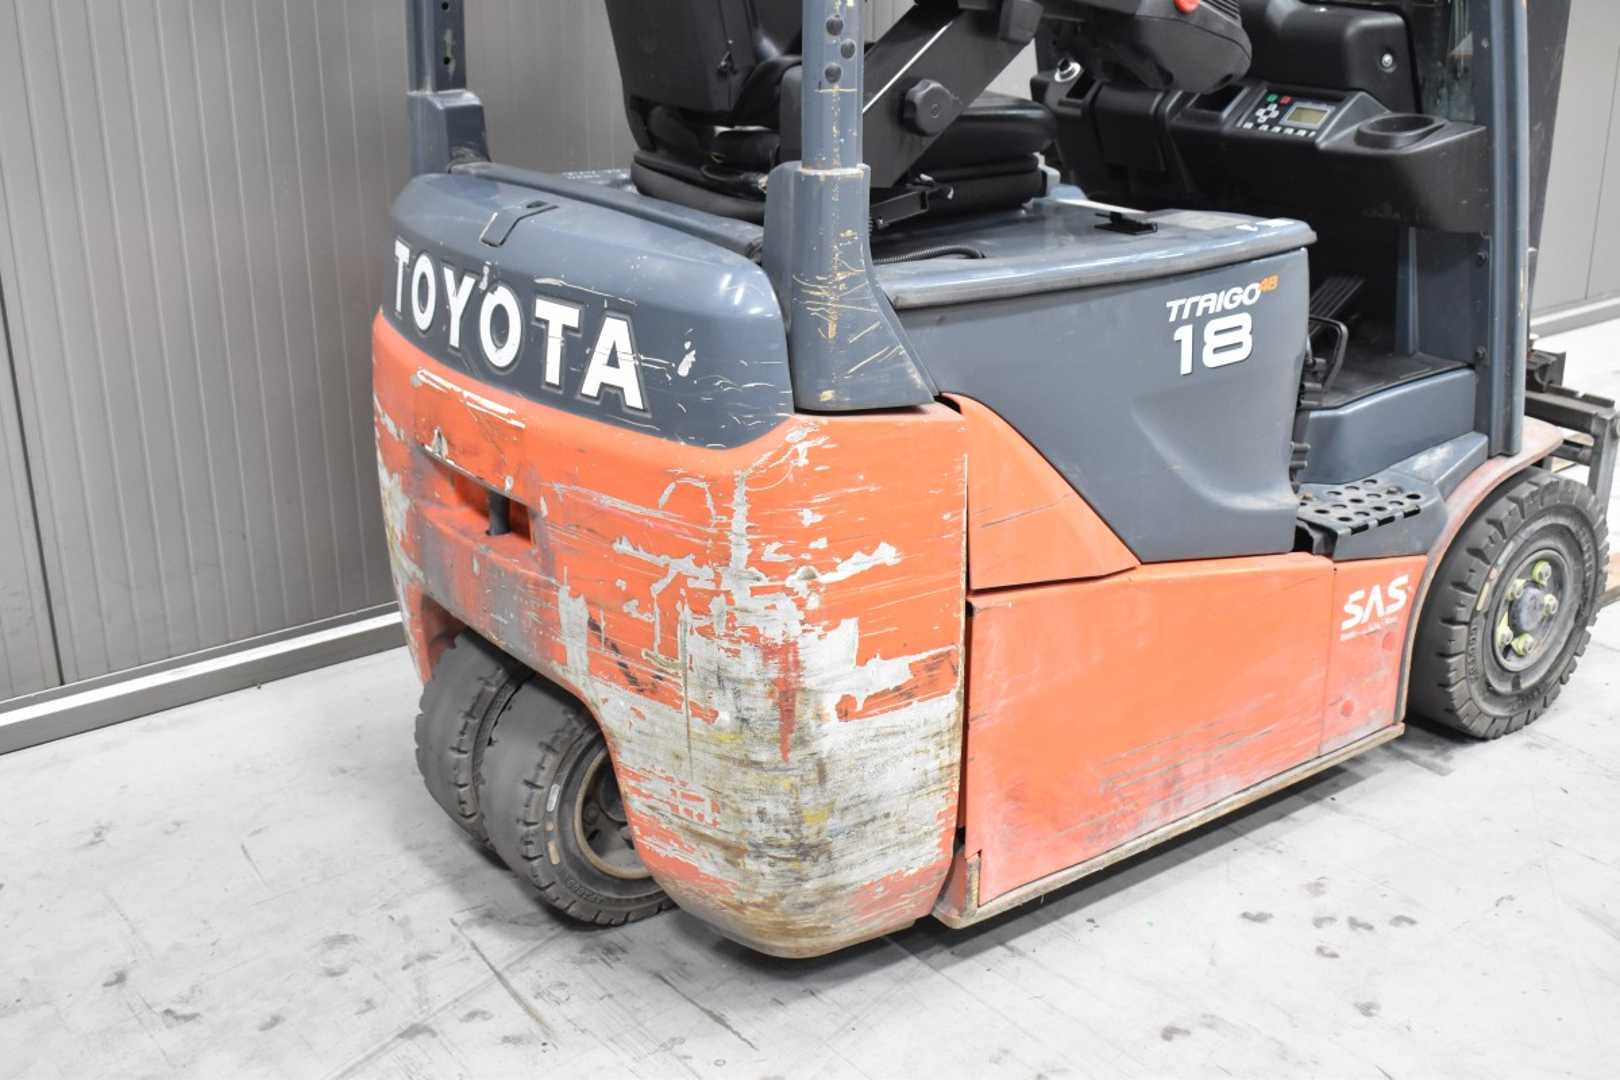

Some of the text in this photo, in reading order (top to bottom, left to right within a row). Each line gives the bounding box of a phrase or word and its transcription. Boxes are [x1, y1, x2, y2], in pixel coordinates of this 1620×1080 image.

[394, 239, 646, 411] TOYOTA
[1173, 312, 1253, 375] 18
[1341, 574, 1409, 631] SAS
